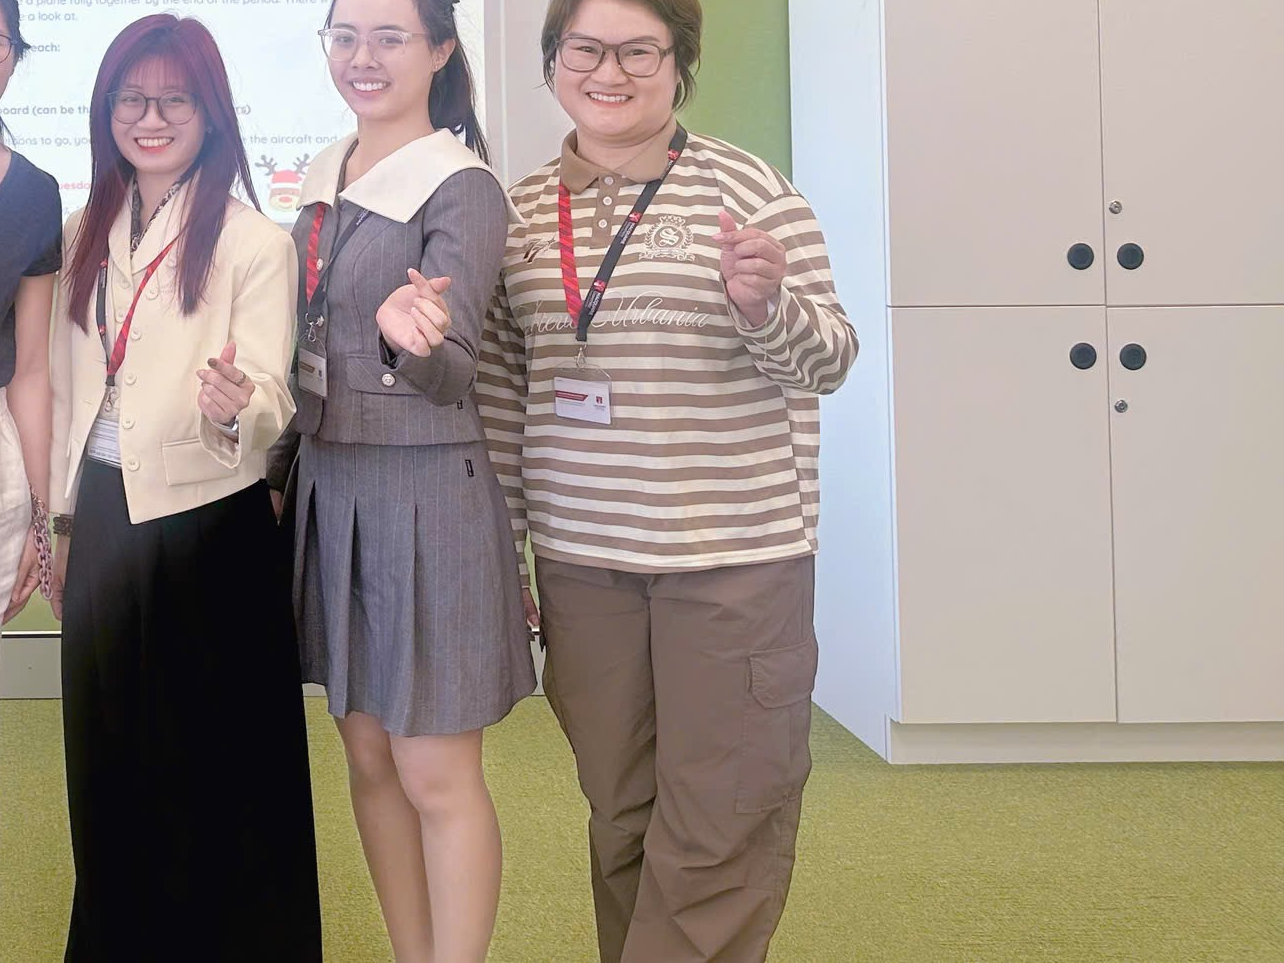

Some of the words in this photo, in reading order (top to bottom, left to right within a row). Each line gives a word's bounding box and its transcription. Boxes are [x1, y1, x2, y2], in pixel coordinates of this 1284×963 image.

[28, 13, 35, 21] a
[38, 11, 61, 21] look
[32, 105, 57, 116] (can
[60, 106, 74, 115] be
[78, 106, 90, 115] th
[41, 136, 51, 145] to
[74, 138, 90, 147] yo
[249, 134, 267, 144] the
[270, 134, 312, 144] aircraft
